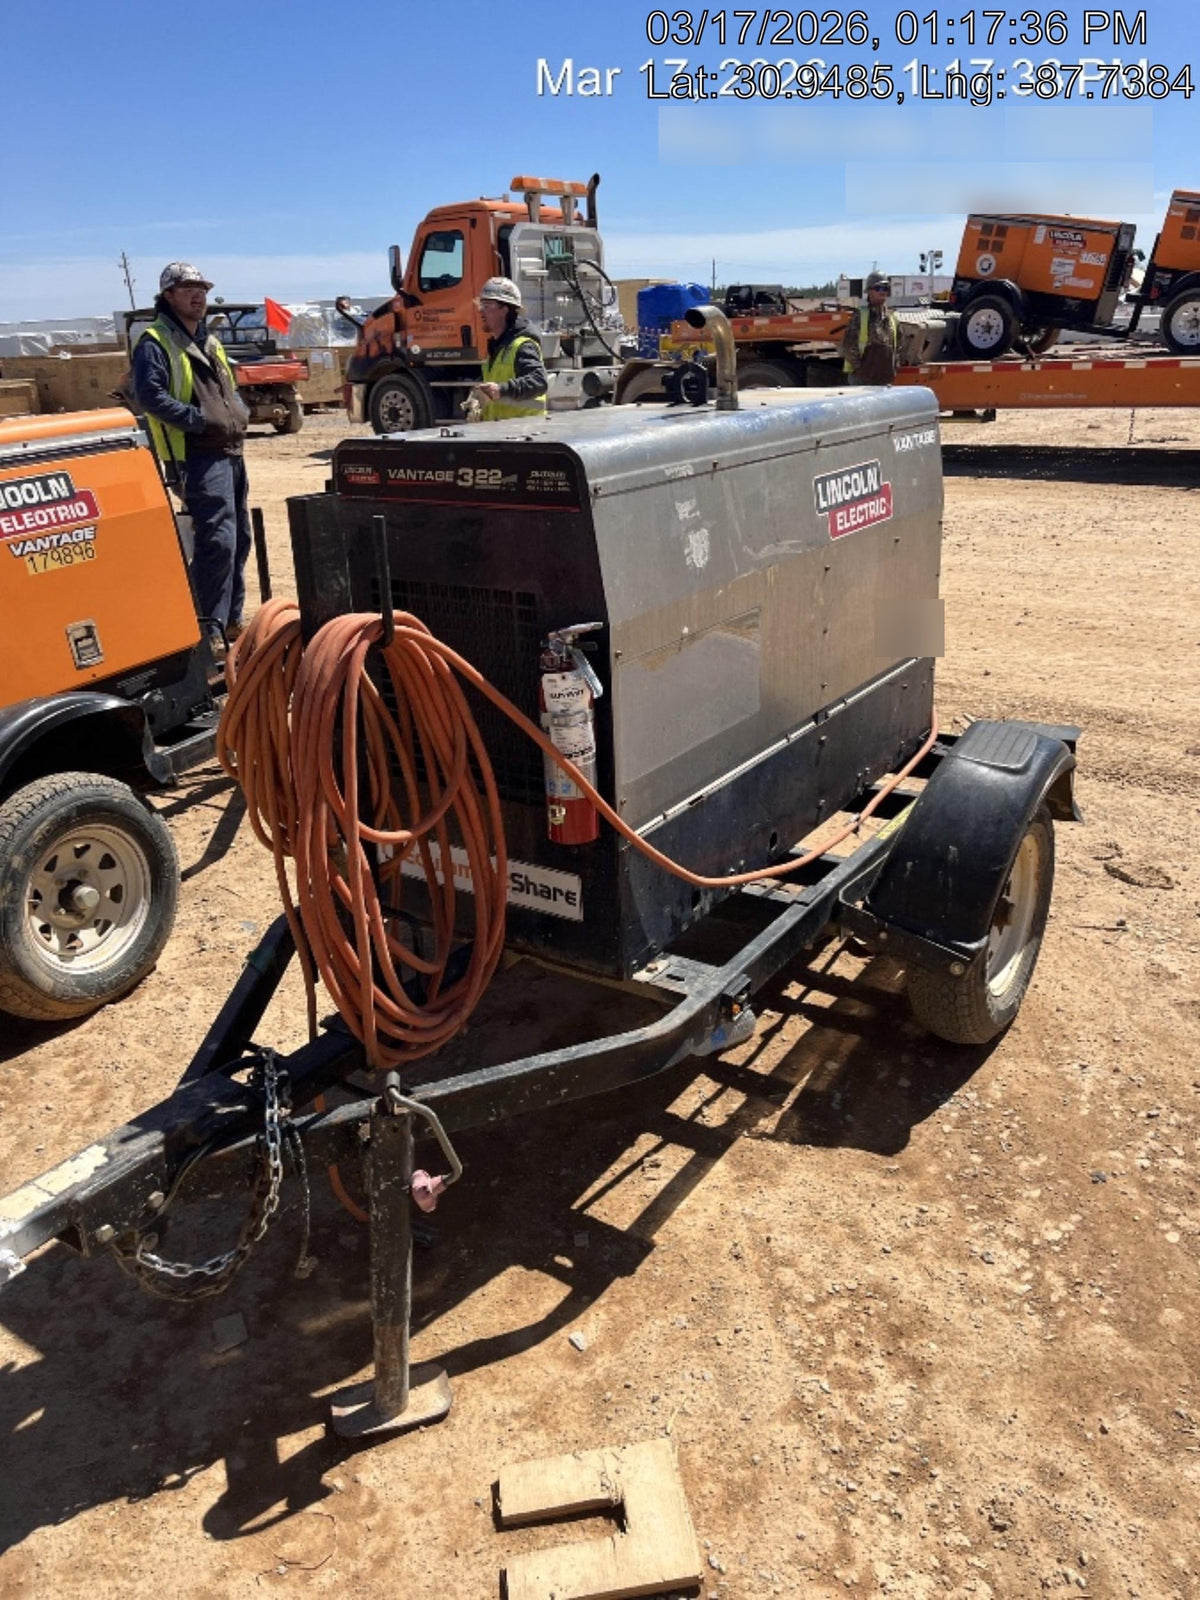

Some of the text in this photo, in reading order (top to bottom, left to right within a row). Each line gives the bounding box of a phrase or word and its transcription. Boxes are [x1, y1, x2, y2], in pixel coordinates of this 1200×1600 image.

[387, 468, 454, 482] VANTAGE
[457, 467, 502, 487] 322
[817, 466, 878, 509] LINCOLN
[836, 497, 887, 531] ELECTRIC
[9, 525, 96, 557] VANTAGE
